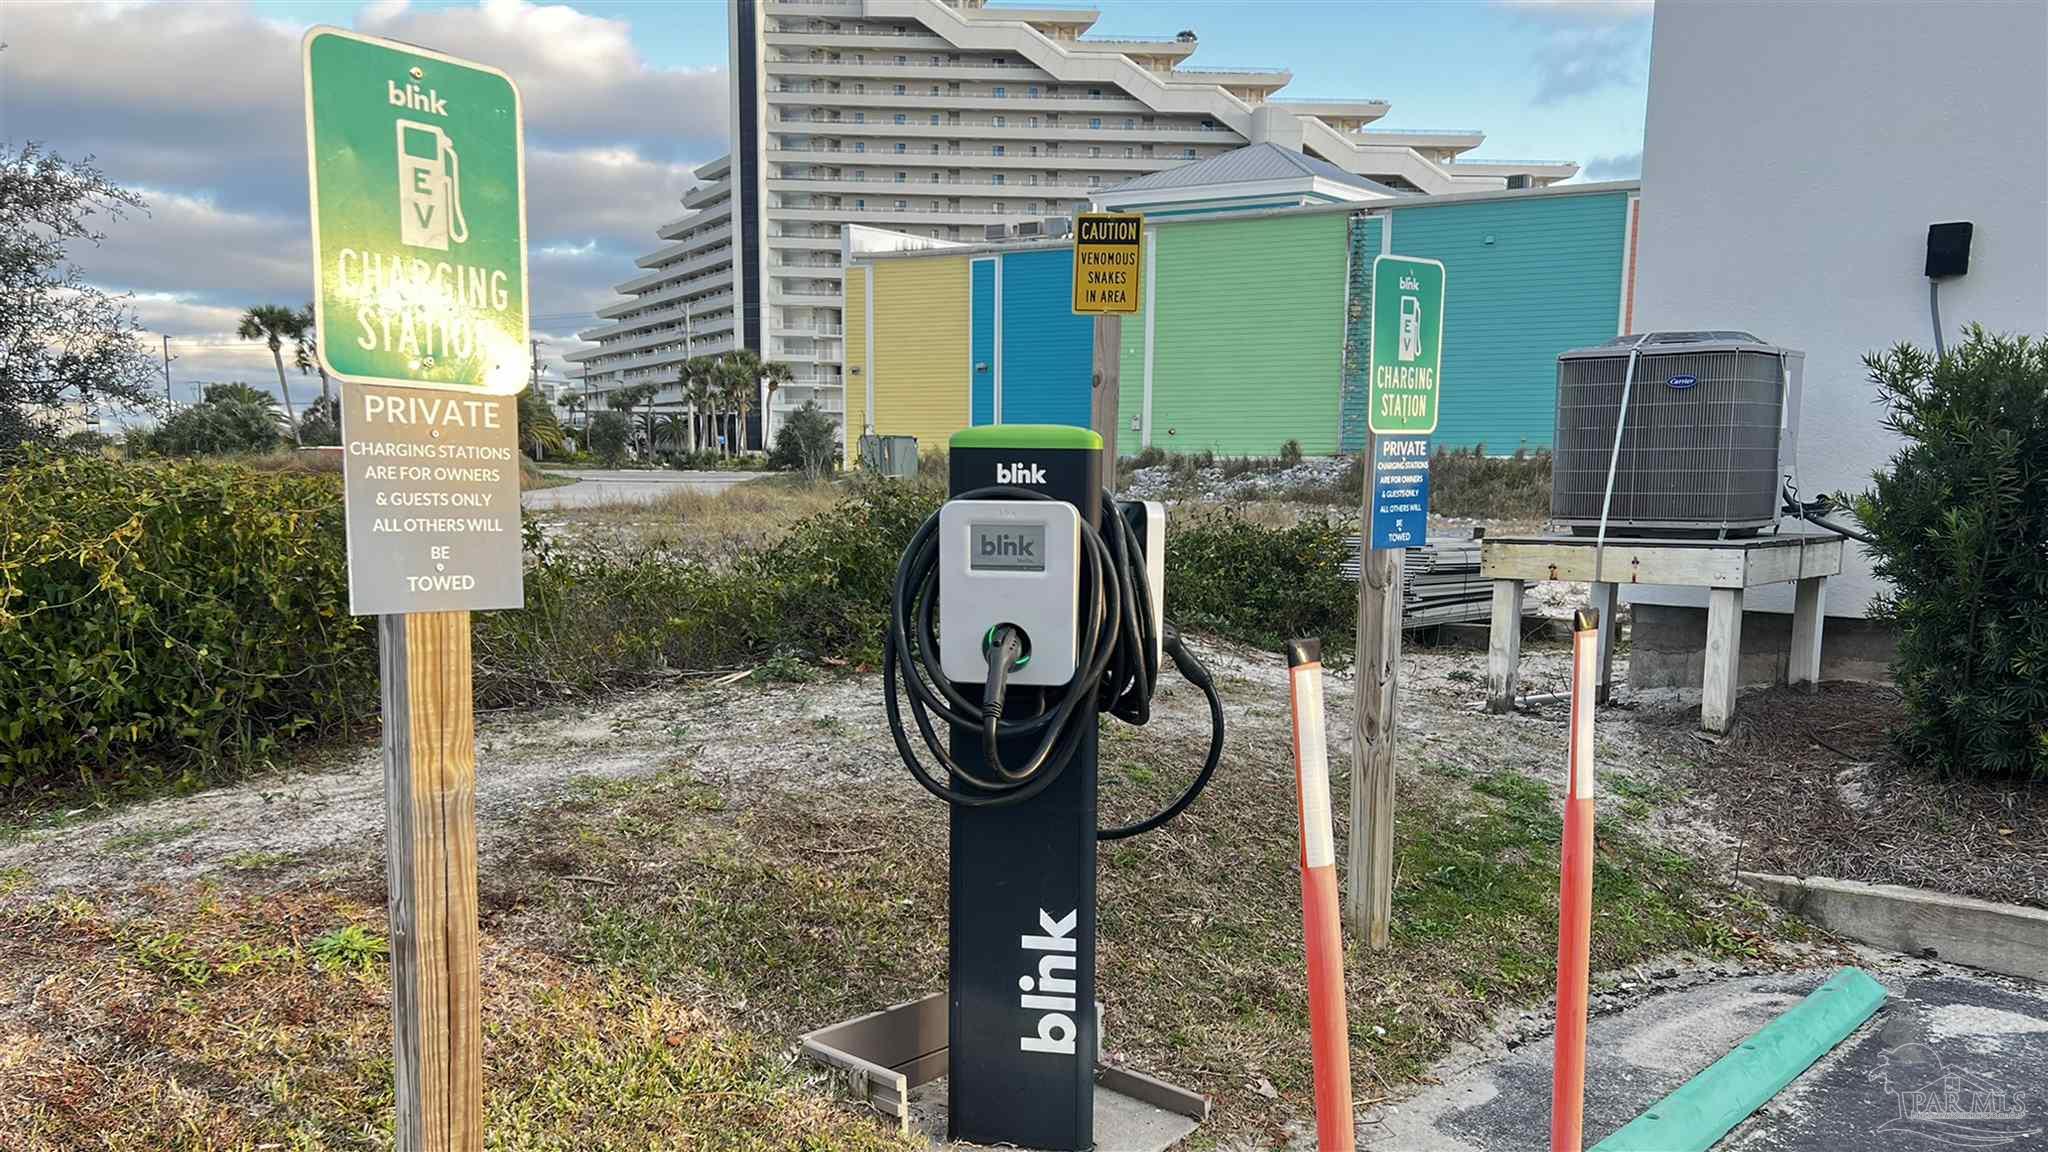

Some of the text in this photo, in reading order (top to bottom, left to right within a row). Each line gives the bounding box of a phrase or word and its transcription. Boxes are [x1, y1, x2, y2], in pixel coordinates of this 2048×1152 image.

[387, 79, 449, 117] blink
[1081, 222, 1137, 240] CAUTION
[1081, 251, 1136, 265] VENOMOUS
[338, 247, 508, 312] CHARGING
[1088, 271, 1127, 284] SNAKES
[1400, 277, 1420, 291] blink
[1086, 290, 1126, 303] IN AREA
[1377, 366, 1433, 390] CHARGING
[364, 395, 501, 429] PRIVATE
[1381, 394, 1427, 417] STATION
[350, 441, 512, 461] CHARGING STATIONS
[1383, 440, 1428, 456] PRIVATE
[365, 466, 500, 482] ARE FOR OWNERS
[996, 463, 1048, 485] blink
[376, 492, 492, 507] & GUESTS ONLY
[373, 518, 503, 532] ALL OTHERS WILL
[981, 534, 1034, 556] blink
[1388, 532, 1411, 542] TOWED
[431, 546, 450, 560] BE
[406, 575, 475, 592] TOWED
[1018, 907, 1077, 1055] blink
